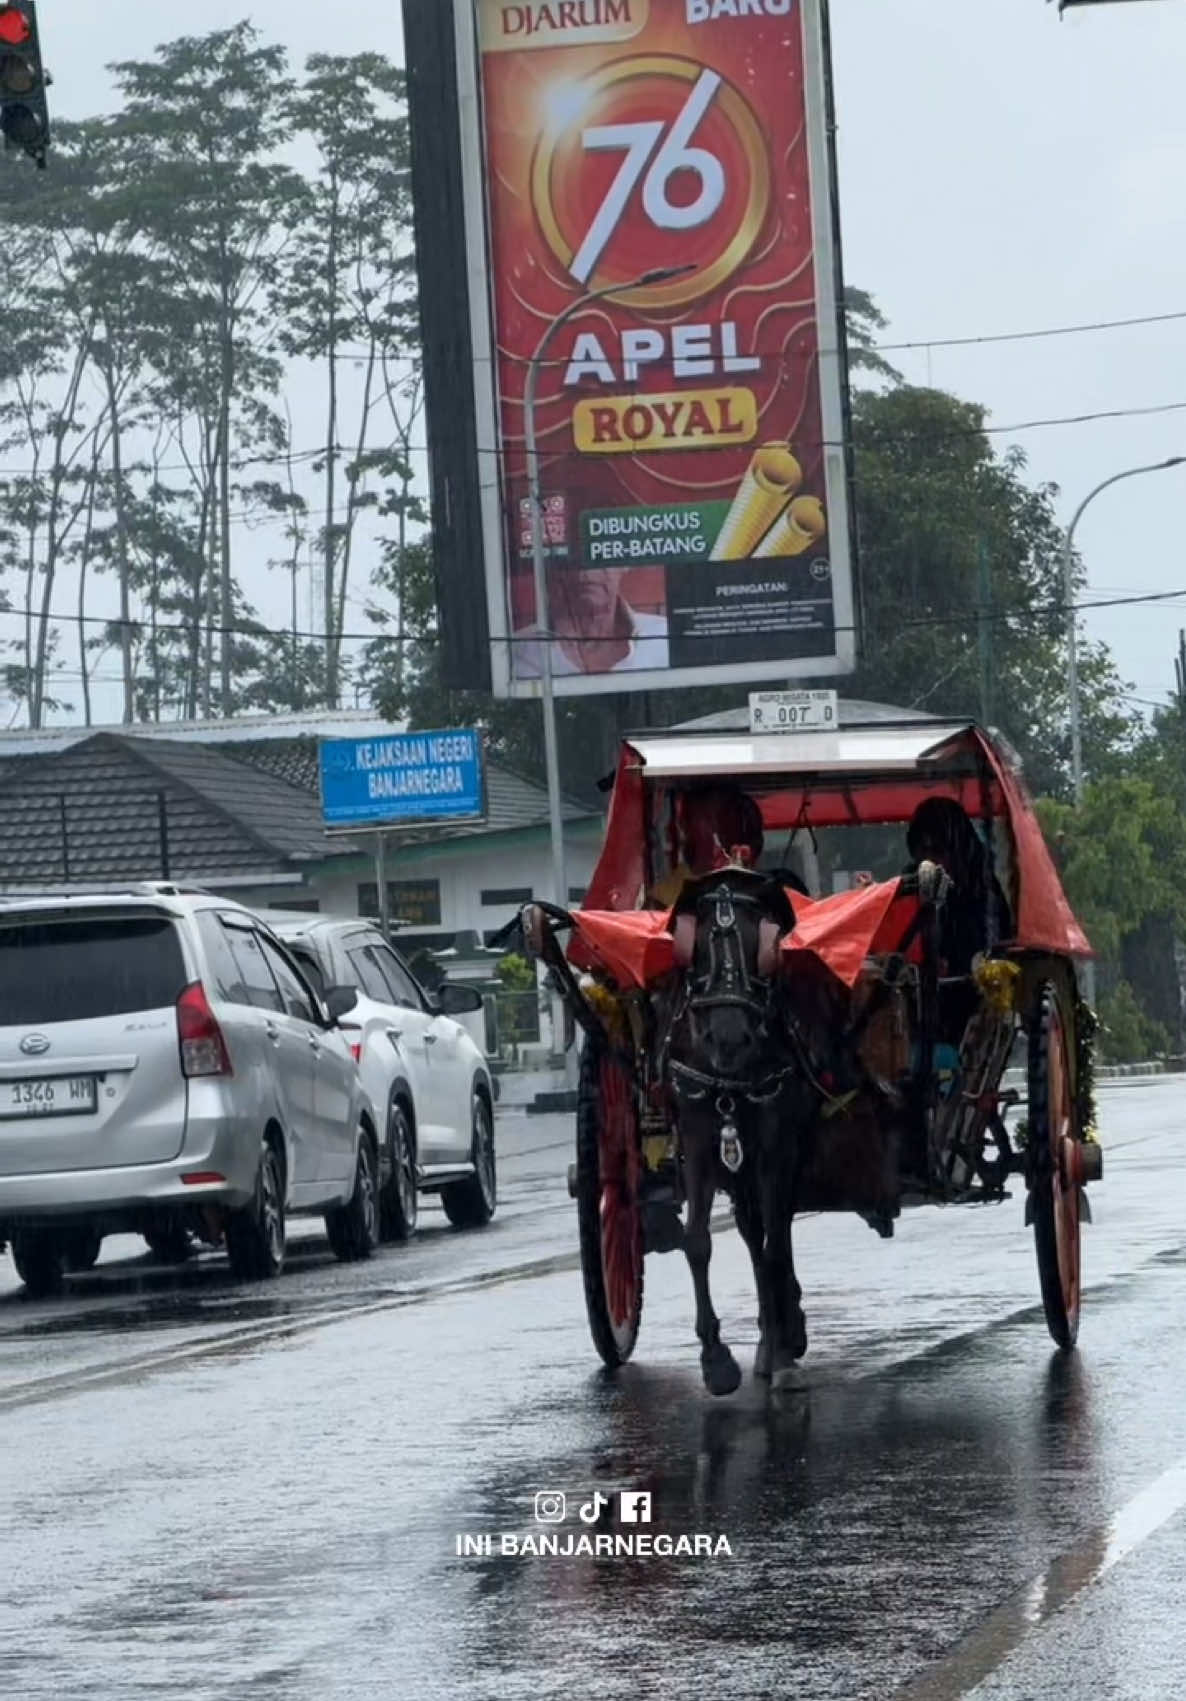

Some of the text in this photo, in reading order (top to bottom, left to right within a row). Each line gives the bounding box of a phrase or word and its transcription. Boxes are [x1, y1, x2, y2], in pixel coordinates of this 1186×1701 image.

[502, 0, 632, 35] DJARUM
[569, 67, 726, 286] 76
[563, 321, 761, 386] APEL
[590, 397, 745, 443] ROYAL
[589, 511, 701, 536] DIBUNGKUS
[590, 534, 706, 560] PER-BATANG
[355, 735, 473, 770] KEJAKSAAN NEGERI
[368, 766, 463, 798] BANJARNEGARA
